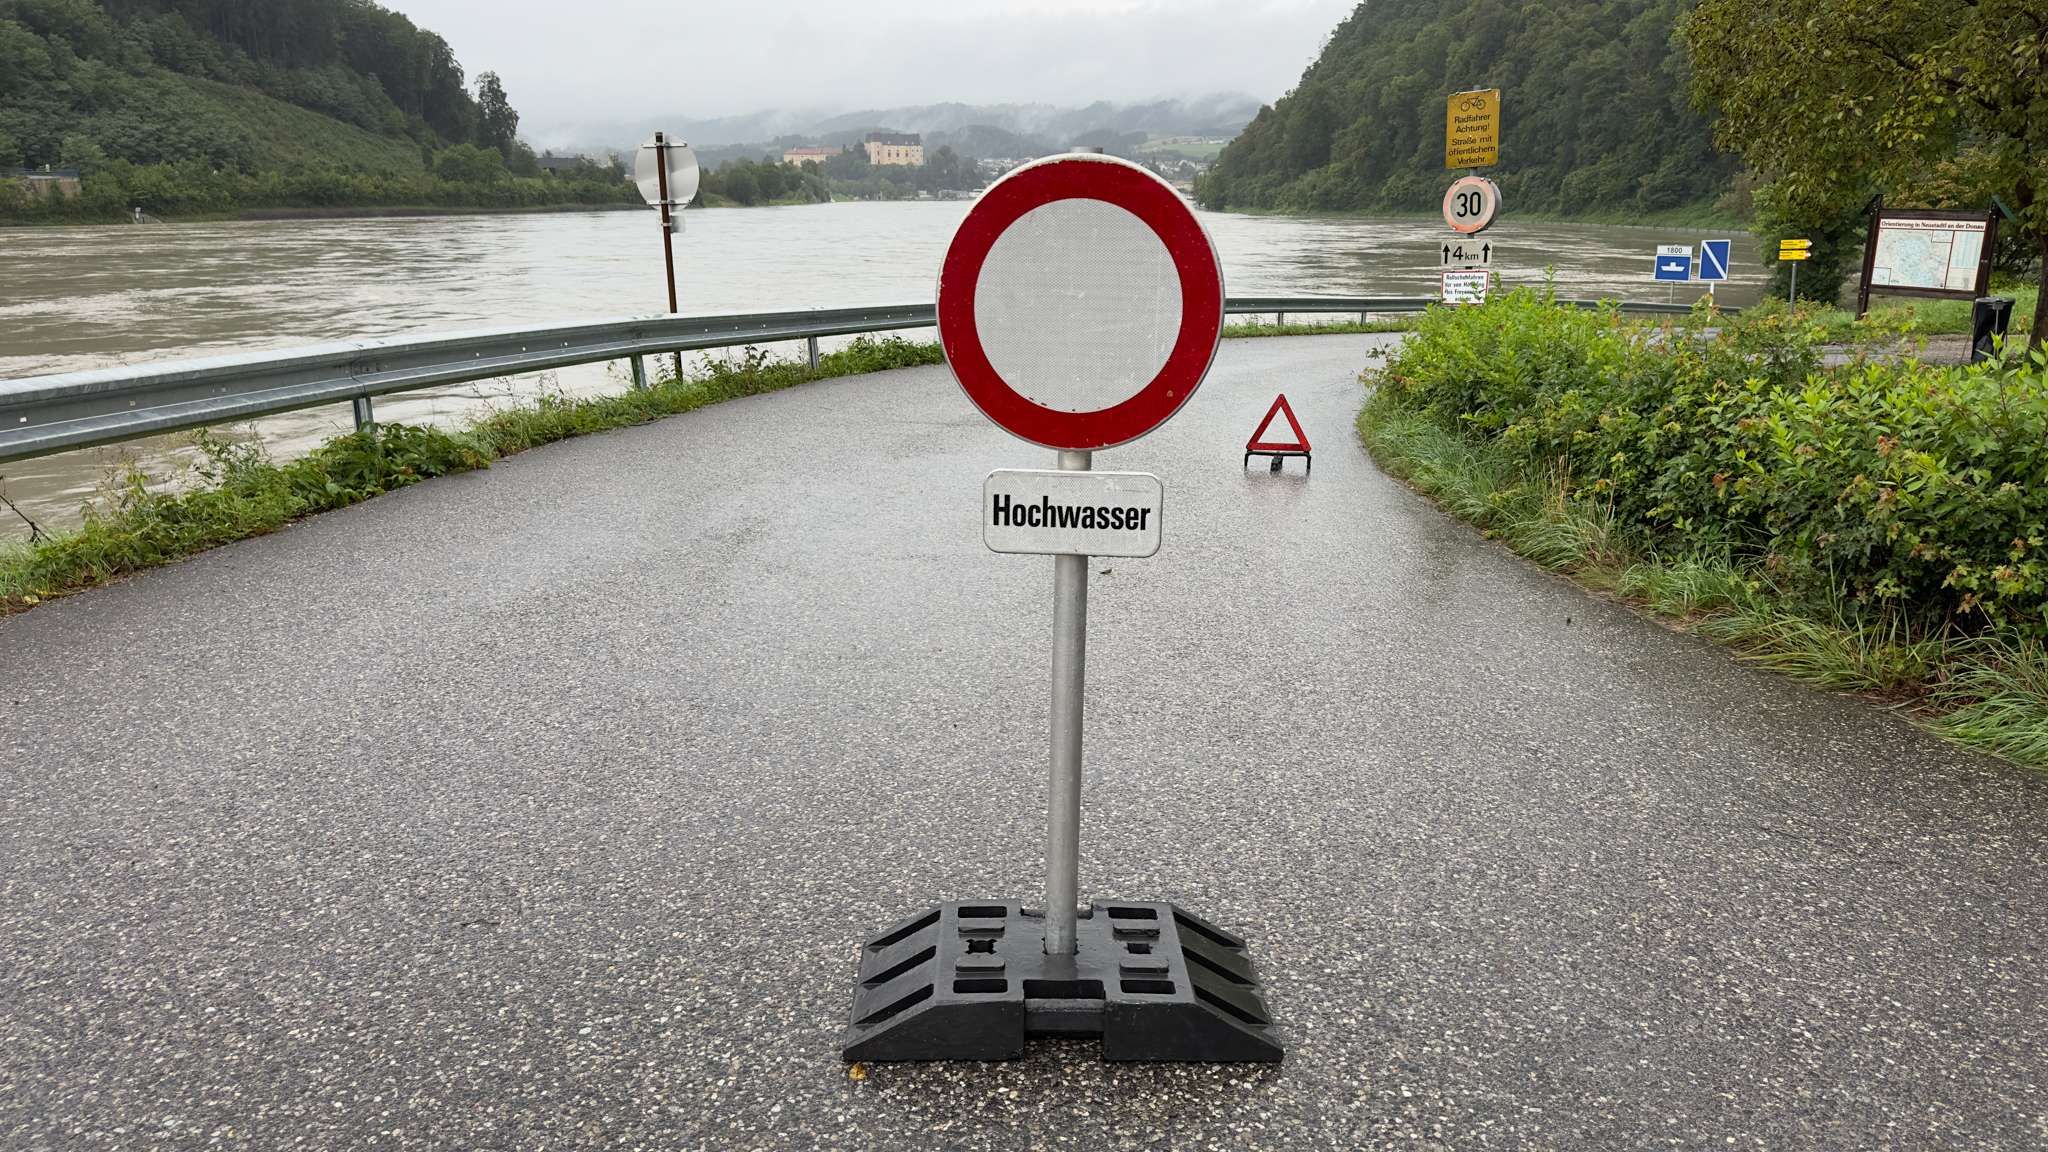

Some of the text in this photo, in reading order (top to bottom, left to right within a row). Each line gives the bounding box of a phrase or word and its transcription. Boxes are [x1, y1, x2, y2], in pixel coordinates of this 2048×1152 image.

[1454, 113, 1491, 124] Radfahrer
[1455, 123, 1490, 133] Achtung!
[1452, 135, 1492, 146] Straße mit
[1456, 191, 1481, 218] 30
[1881, 221, 1914, 229] Orientierung
[993, 493, 1151, 531] Hochwasser
